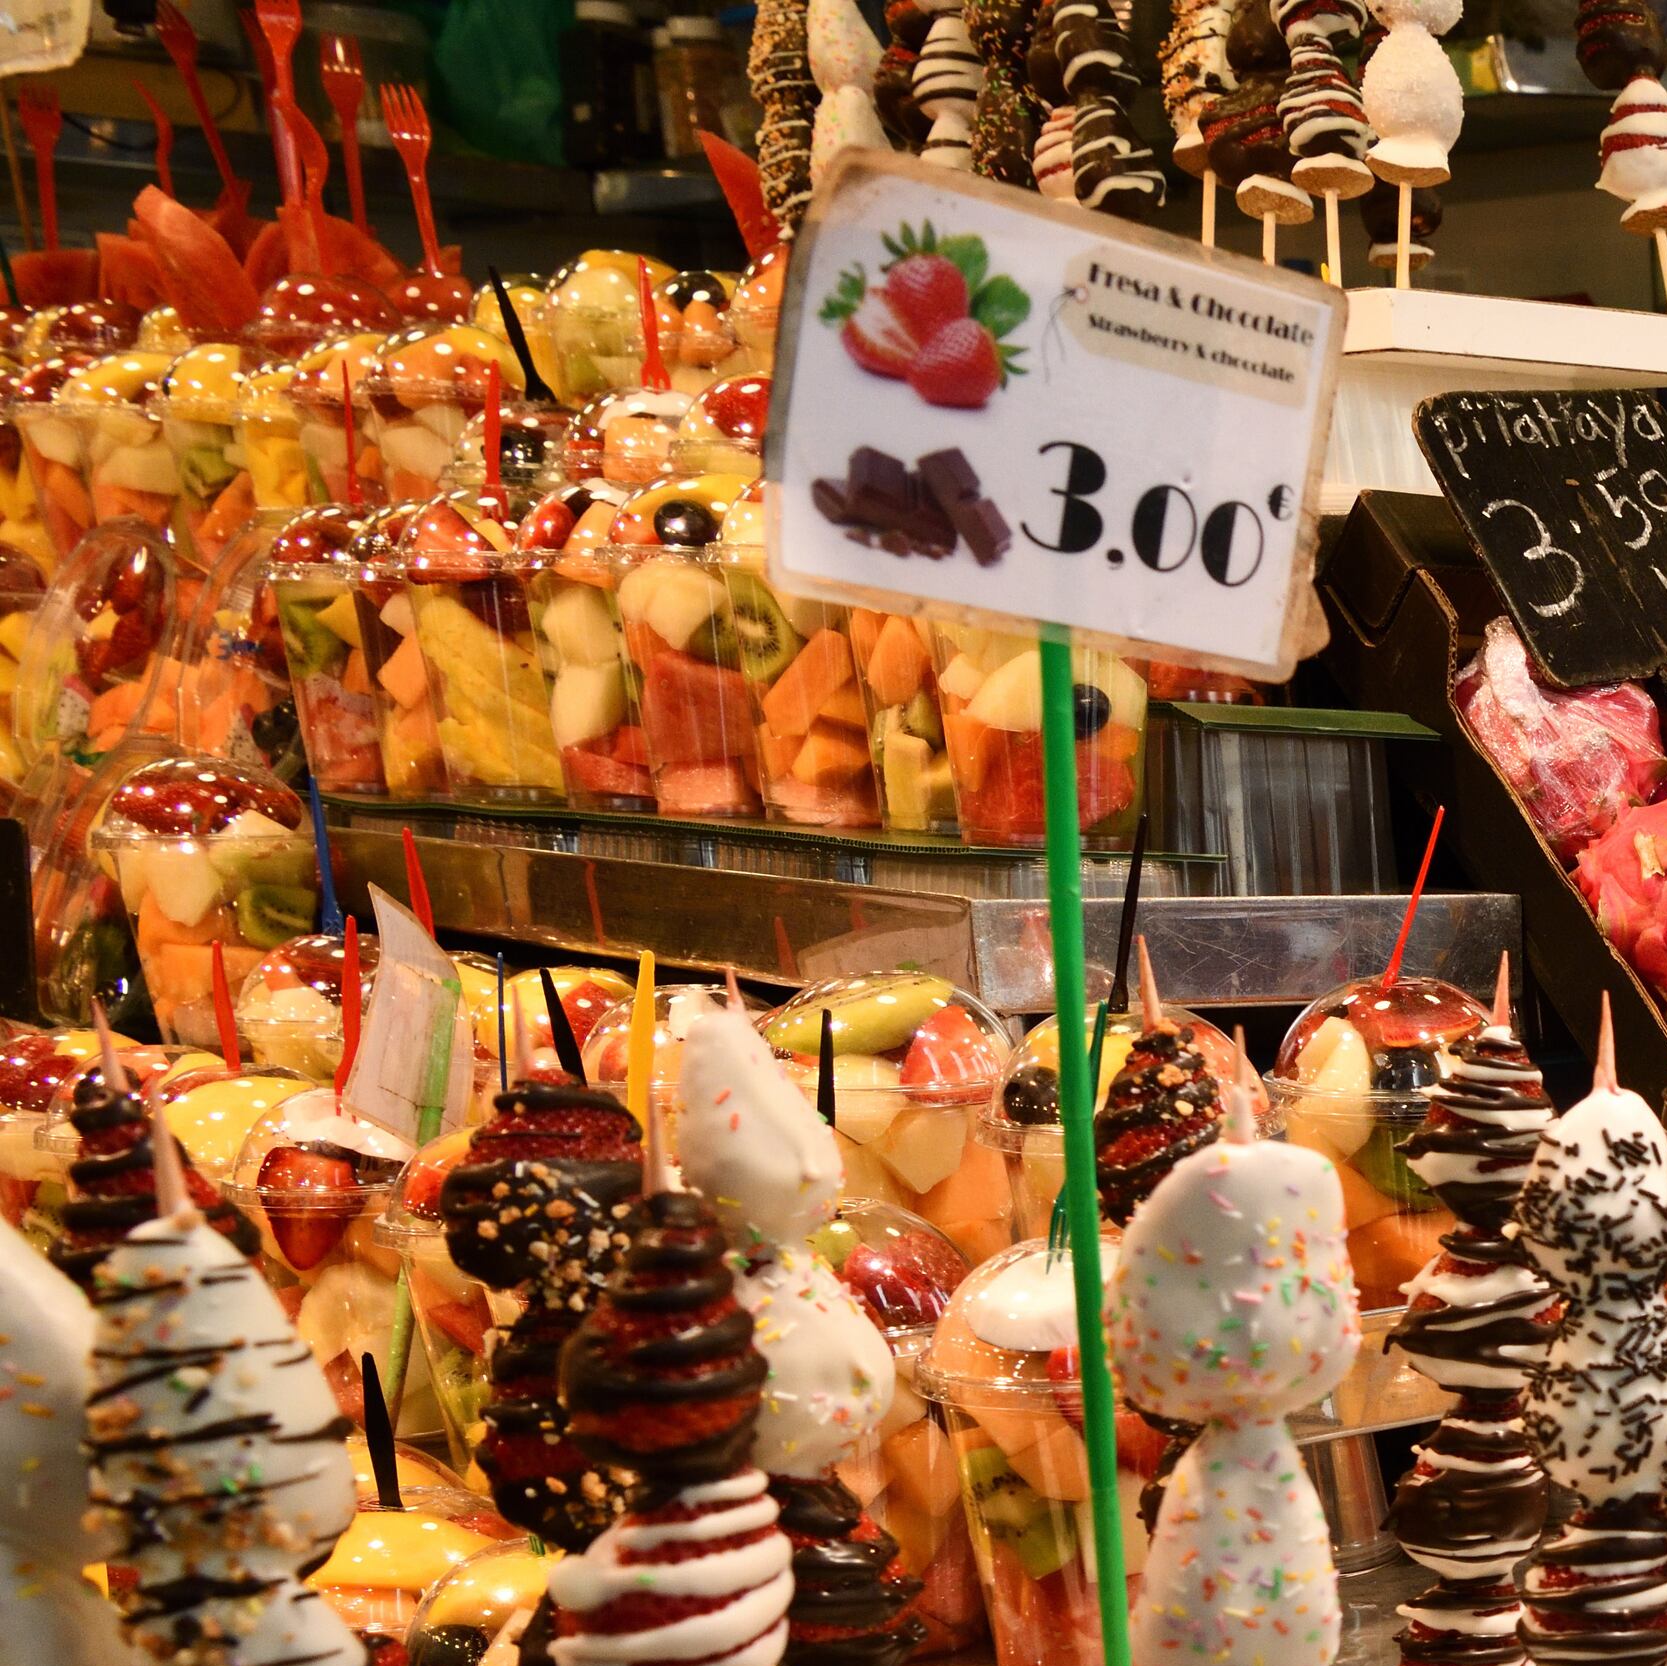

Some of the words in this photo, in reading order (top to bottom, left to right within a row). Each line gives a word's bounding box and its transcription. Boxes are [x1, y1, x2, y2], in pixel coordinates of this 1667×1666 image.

[1088, 262, 1161, 303] Fresa
[1190, 293, 1314, 347] Chocolate
[1088, 313, 1189, 352] Strawberry
[1210, 349, 1295, 384] chocolate
